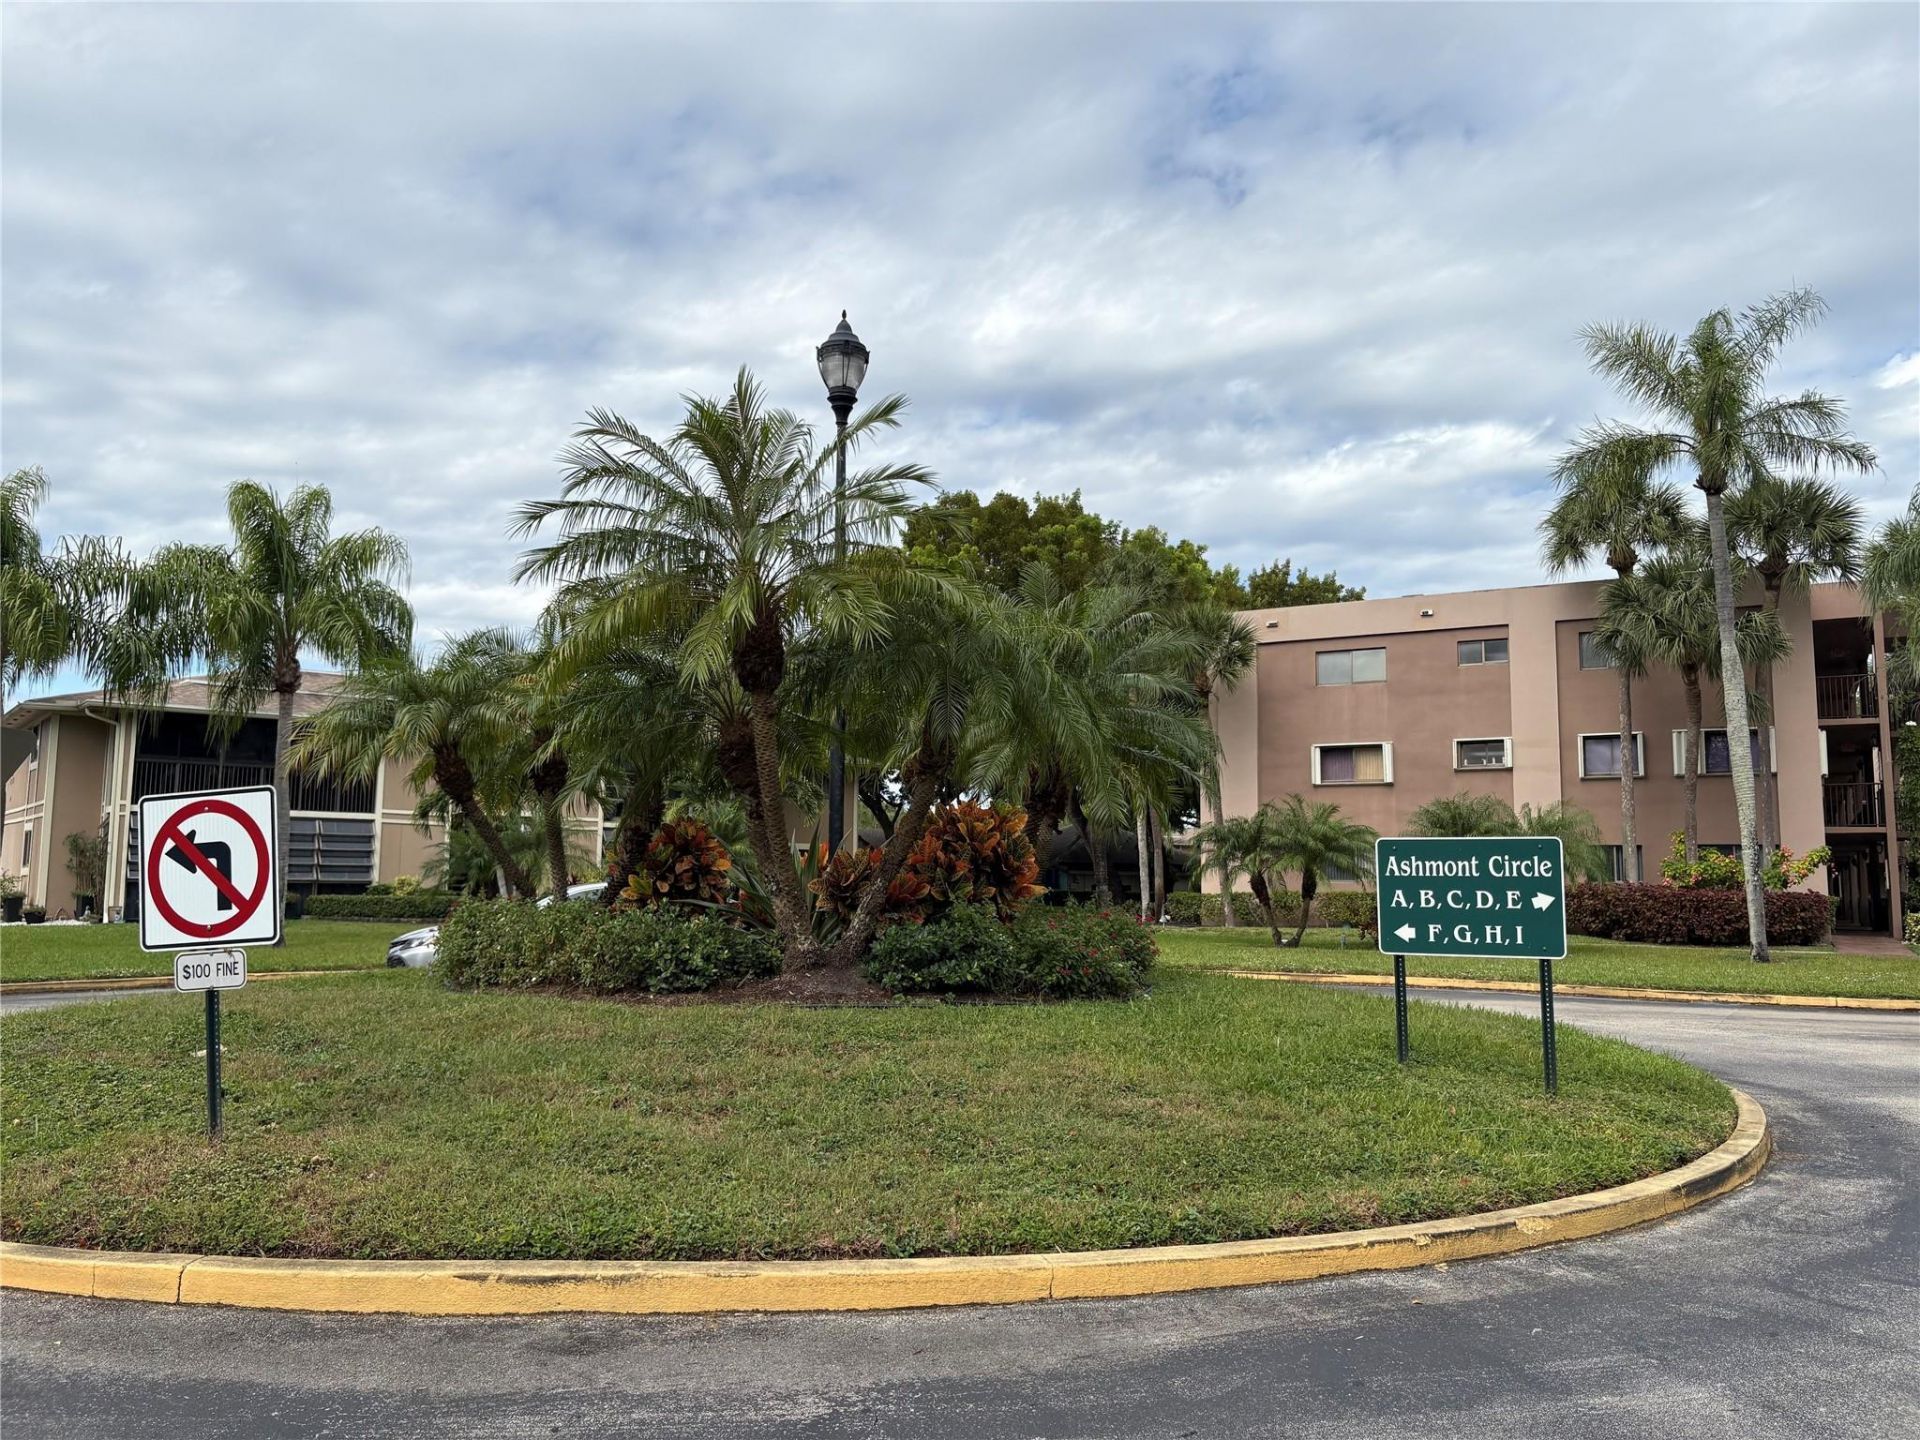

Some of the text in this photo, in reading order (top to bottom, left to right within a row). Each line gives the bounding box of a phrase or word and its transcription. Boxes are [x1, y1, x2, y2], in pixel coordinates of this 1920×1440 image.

[1385, 855, 1553, 878] Ashmont Circle
[182, 961, 240, 980] $100 FINE
